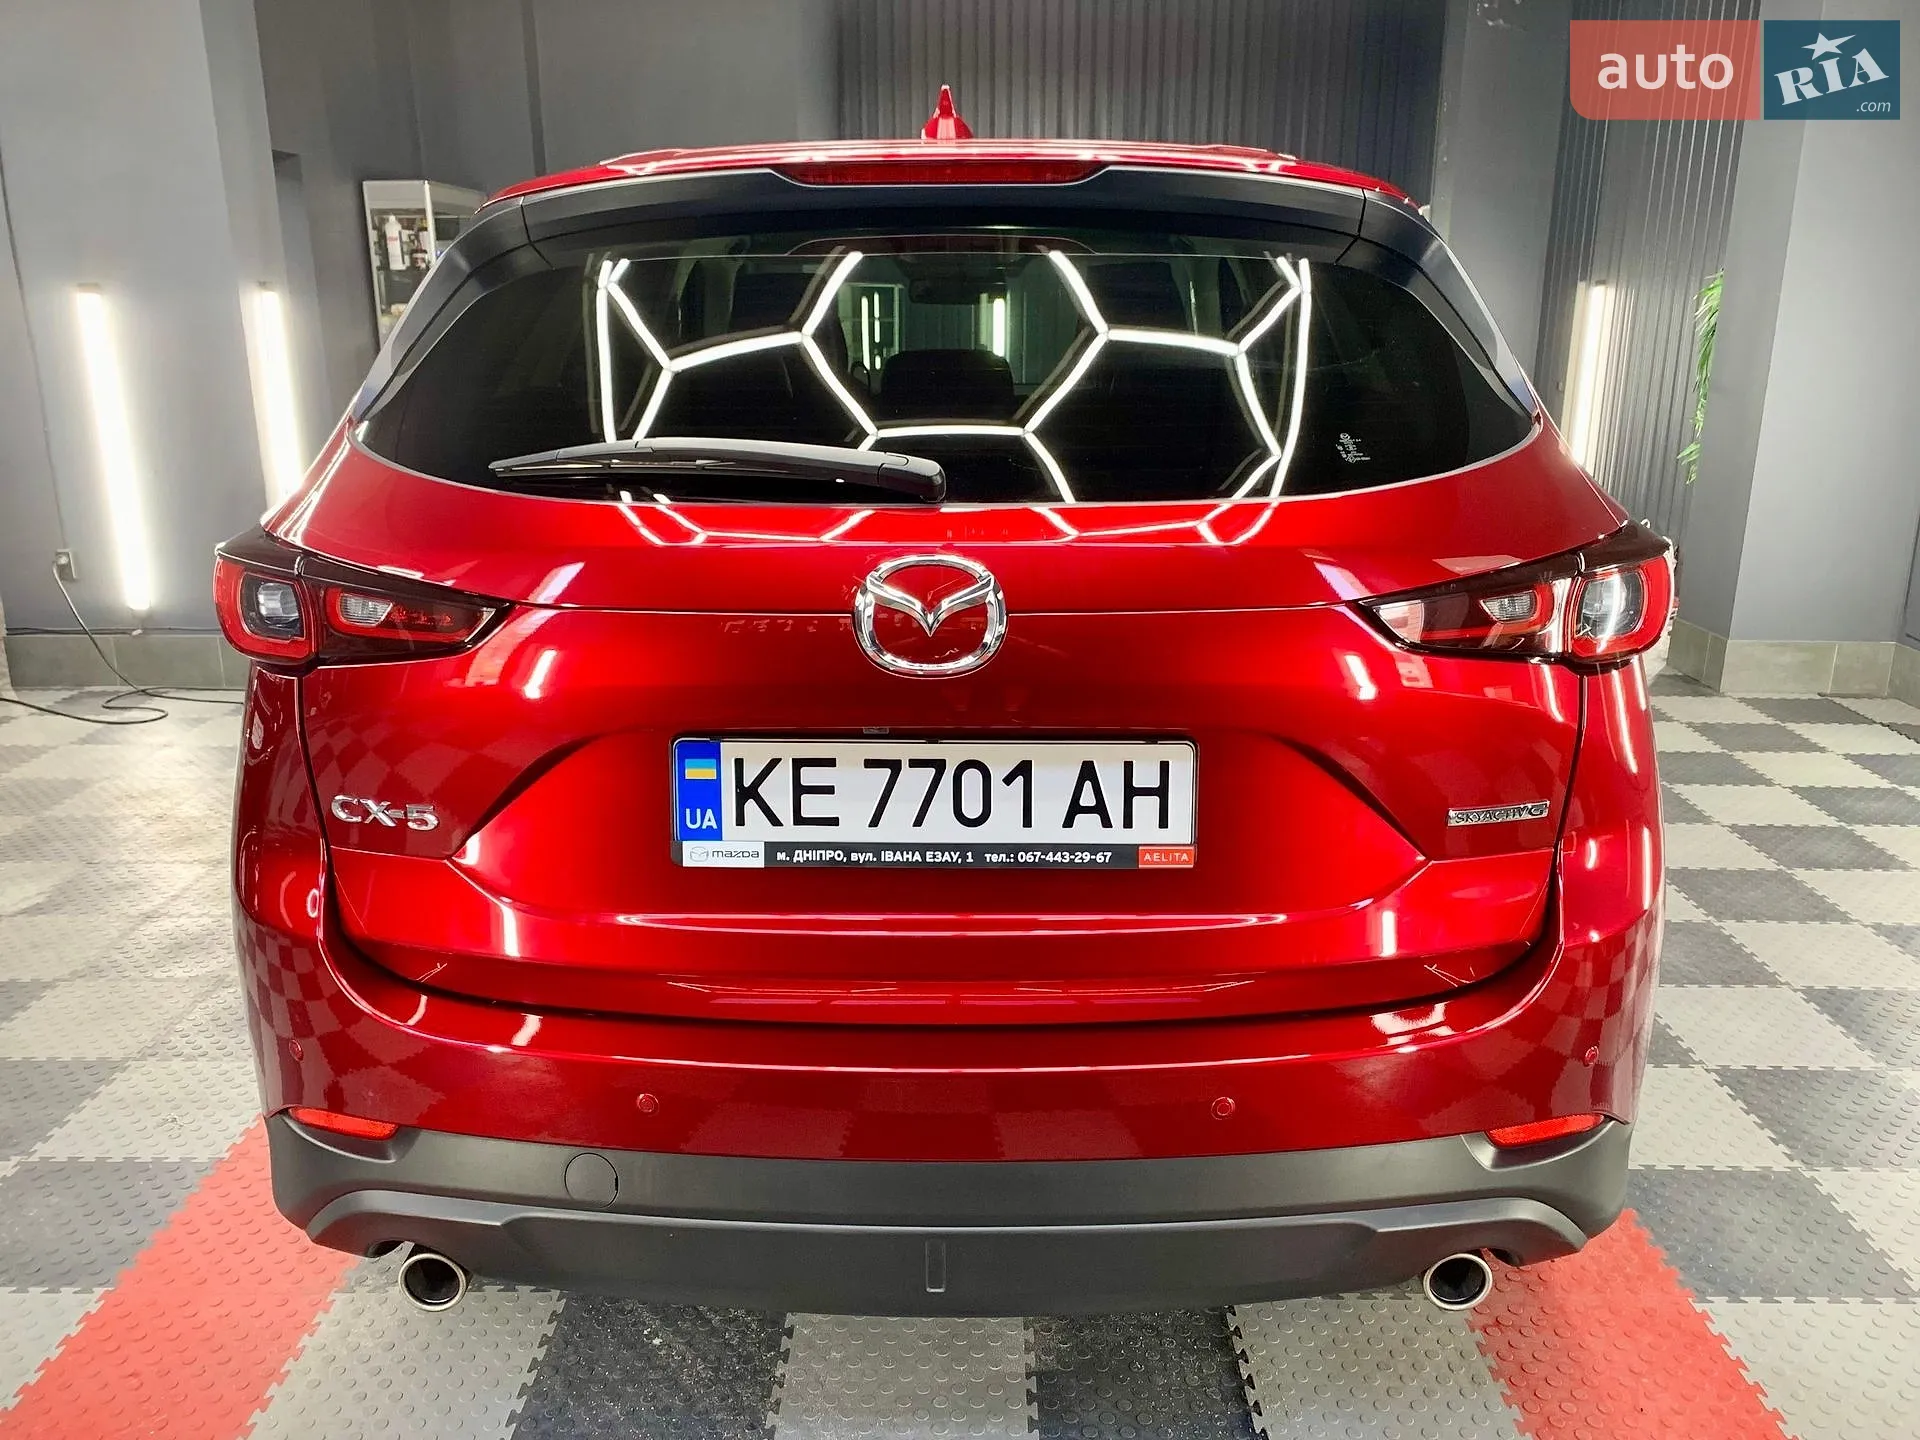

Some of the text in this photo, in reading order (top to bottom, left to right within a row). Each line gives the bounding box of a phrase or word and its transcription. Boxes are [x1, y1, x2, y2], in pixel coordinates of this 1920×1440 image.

[733, 756, 1170, 829] KE 7701 AH
[331, 795, 439, 831] CX-5
[685, 808, 718, 829] UA
[711, 849, 760, 859] mazda
[776, 850, 1113, 864] м. ДНІПРО, вул. ІВАНА ЕЗАУ, 1 тел.: 067-443-29-67
[1143, 852, 1189, 862] AELITA
